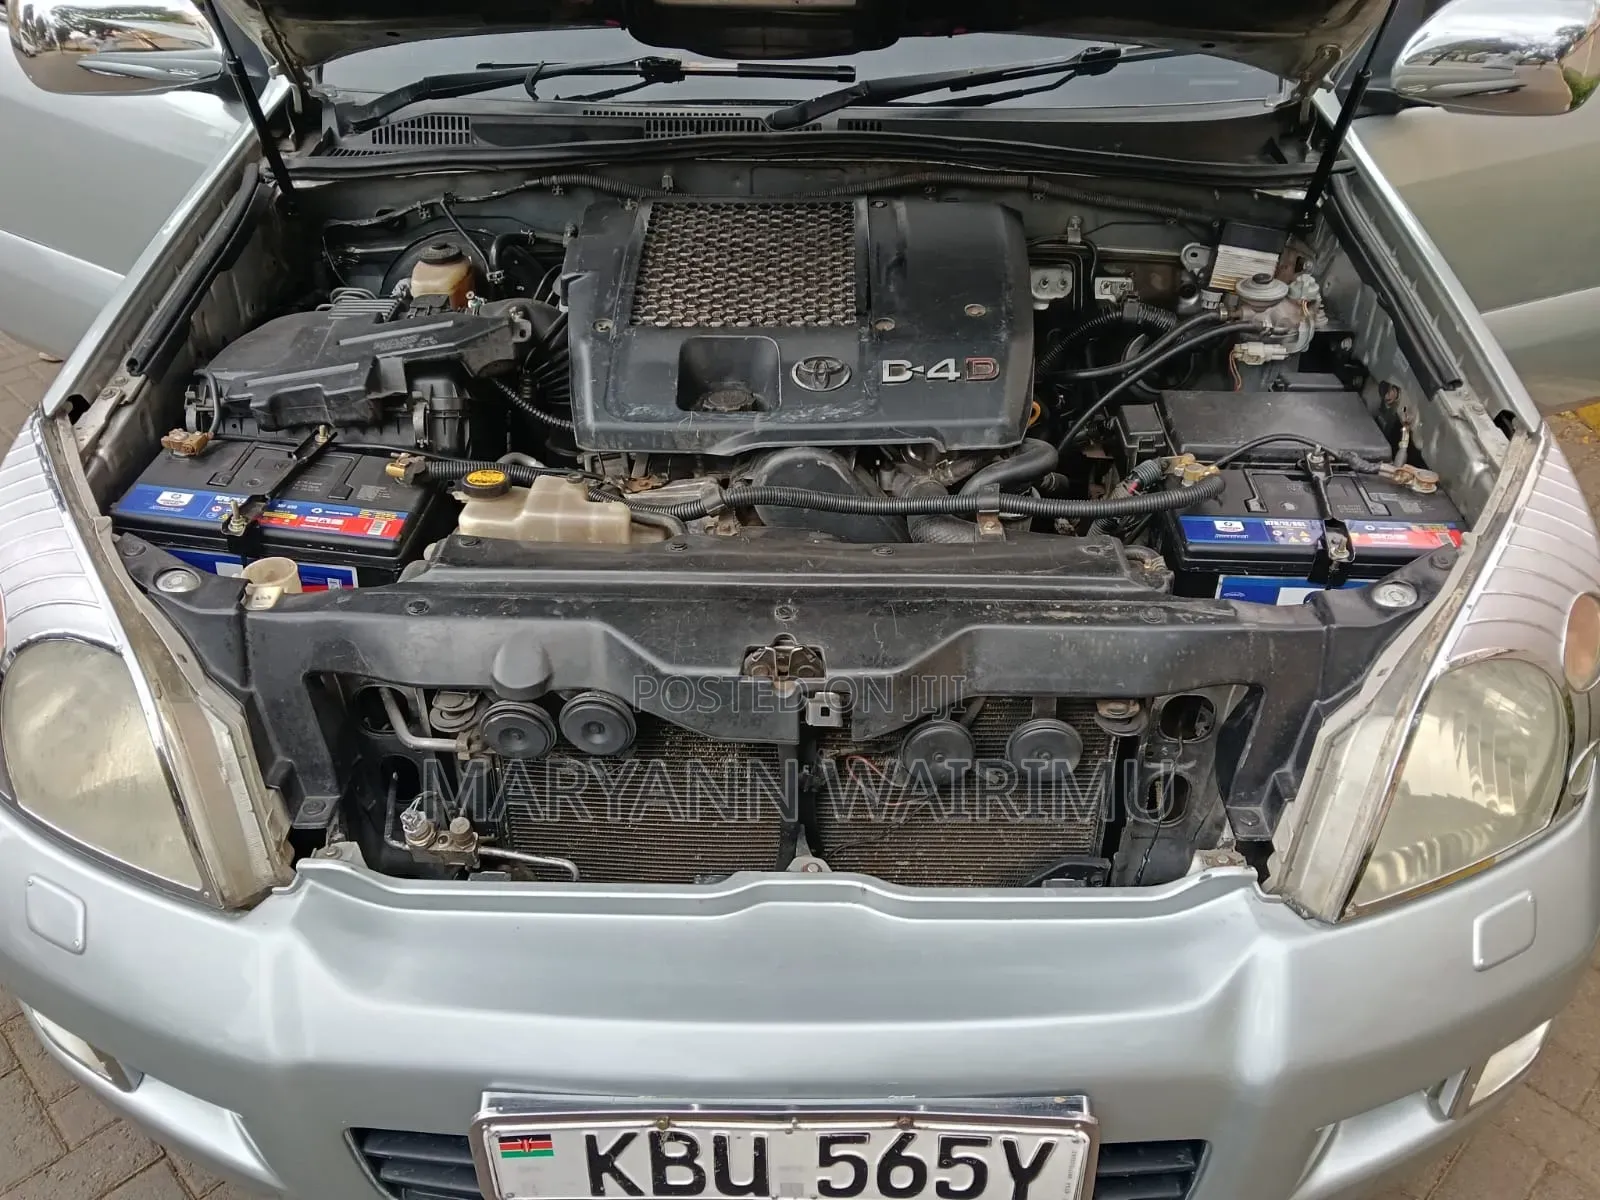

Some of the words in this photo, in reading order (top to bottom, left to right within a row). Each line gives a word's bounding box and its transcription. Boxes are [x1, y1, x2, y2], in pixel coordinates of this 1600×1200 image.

[881, 357, 1000, 384] D-4D
[585, 1132, 770, 1197] KBU
[815, 1132, 1058, 1200] 565Y
